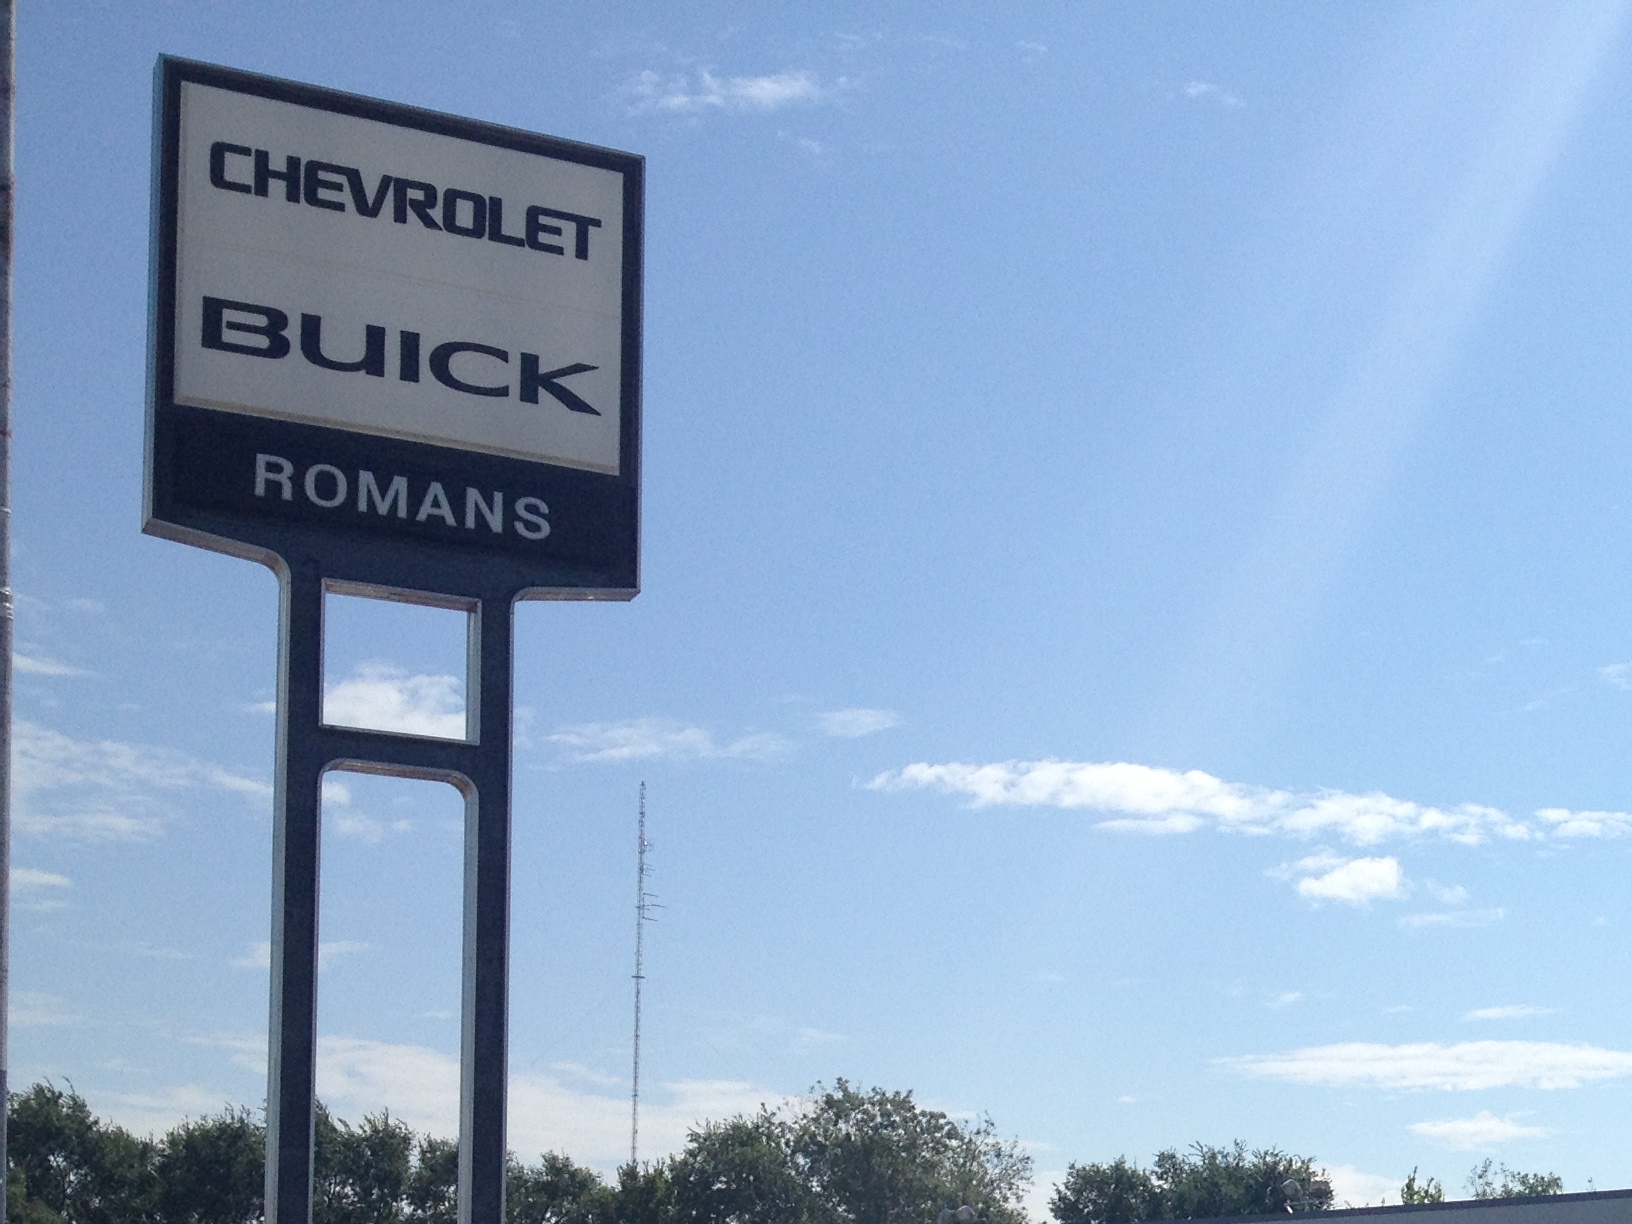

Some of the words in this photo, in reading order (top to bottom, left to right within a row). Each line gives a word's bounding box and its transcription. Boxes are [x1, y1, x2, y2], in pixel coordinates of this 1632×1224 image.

[209, 140, 603, 261] CHEVROLET
[200, 295, 603, 417] BUICK
[253, 451, 552, 540] ROMANS
